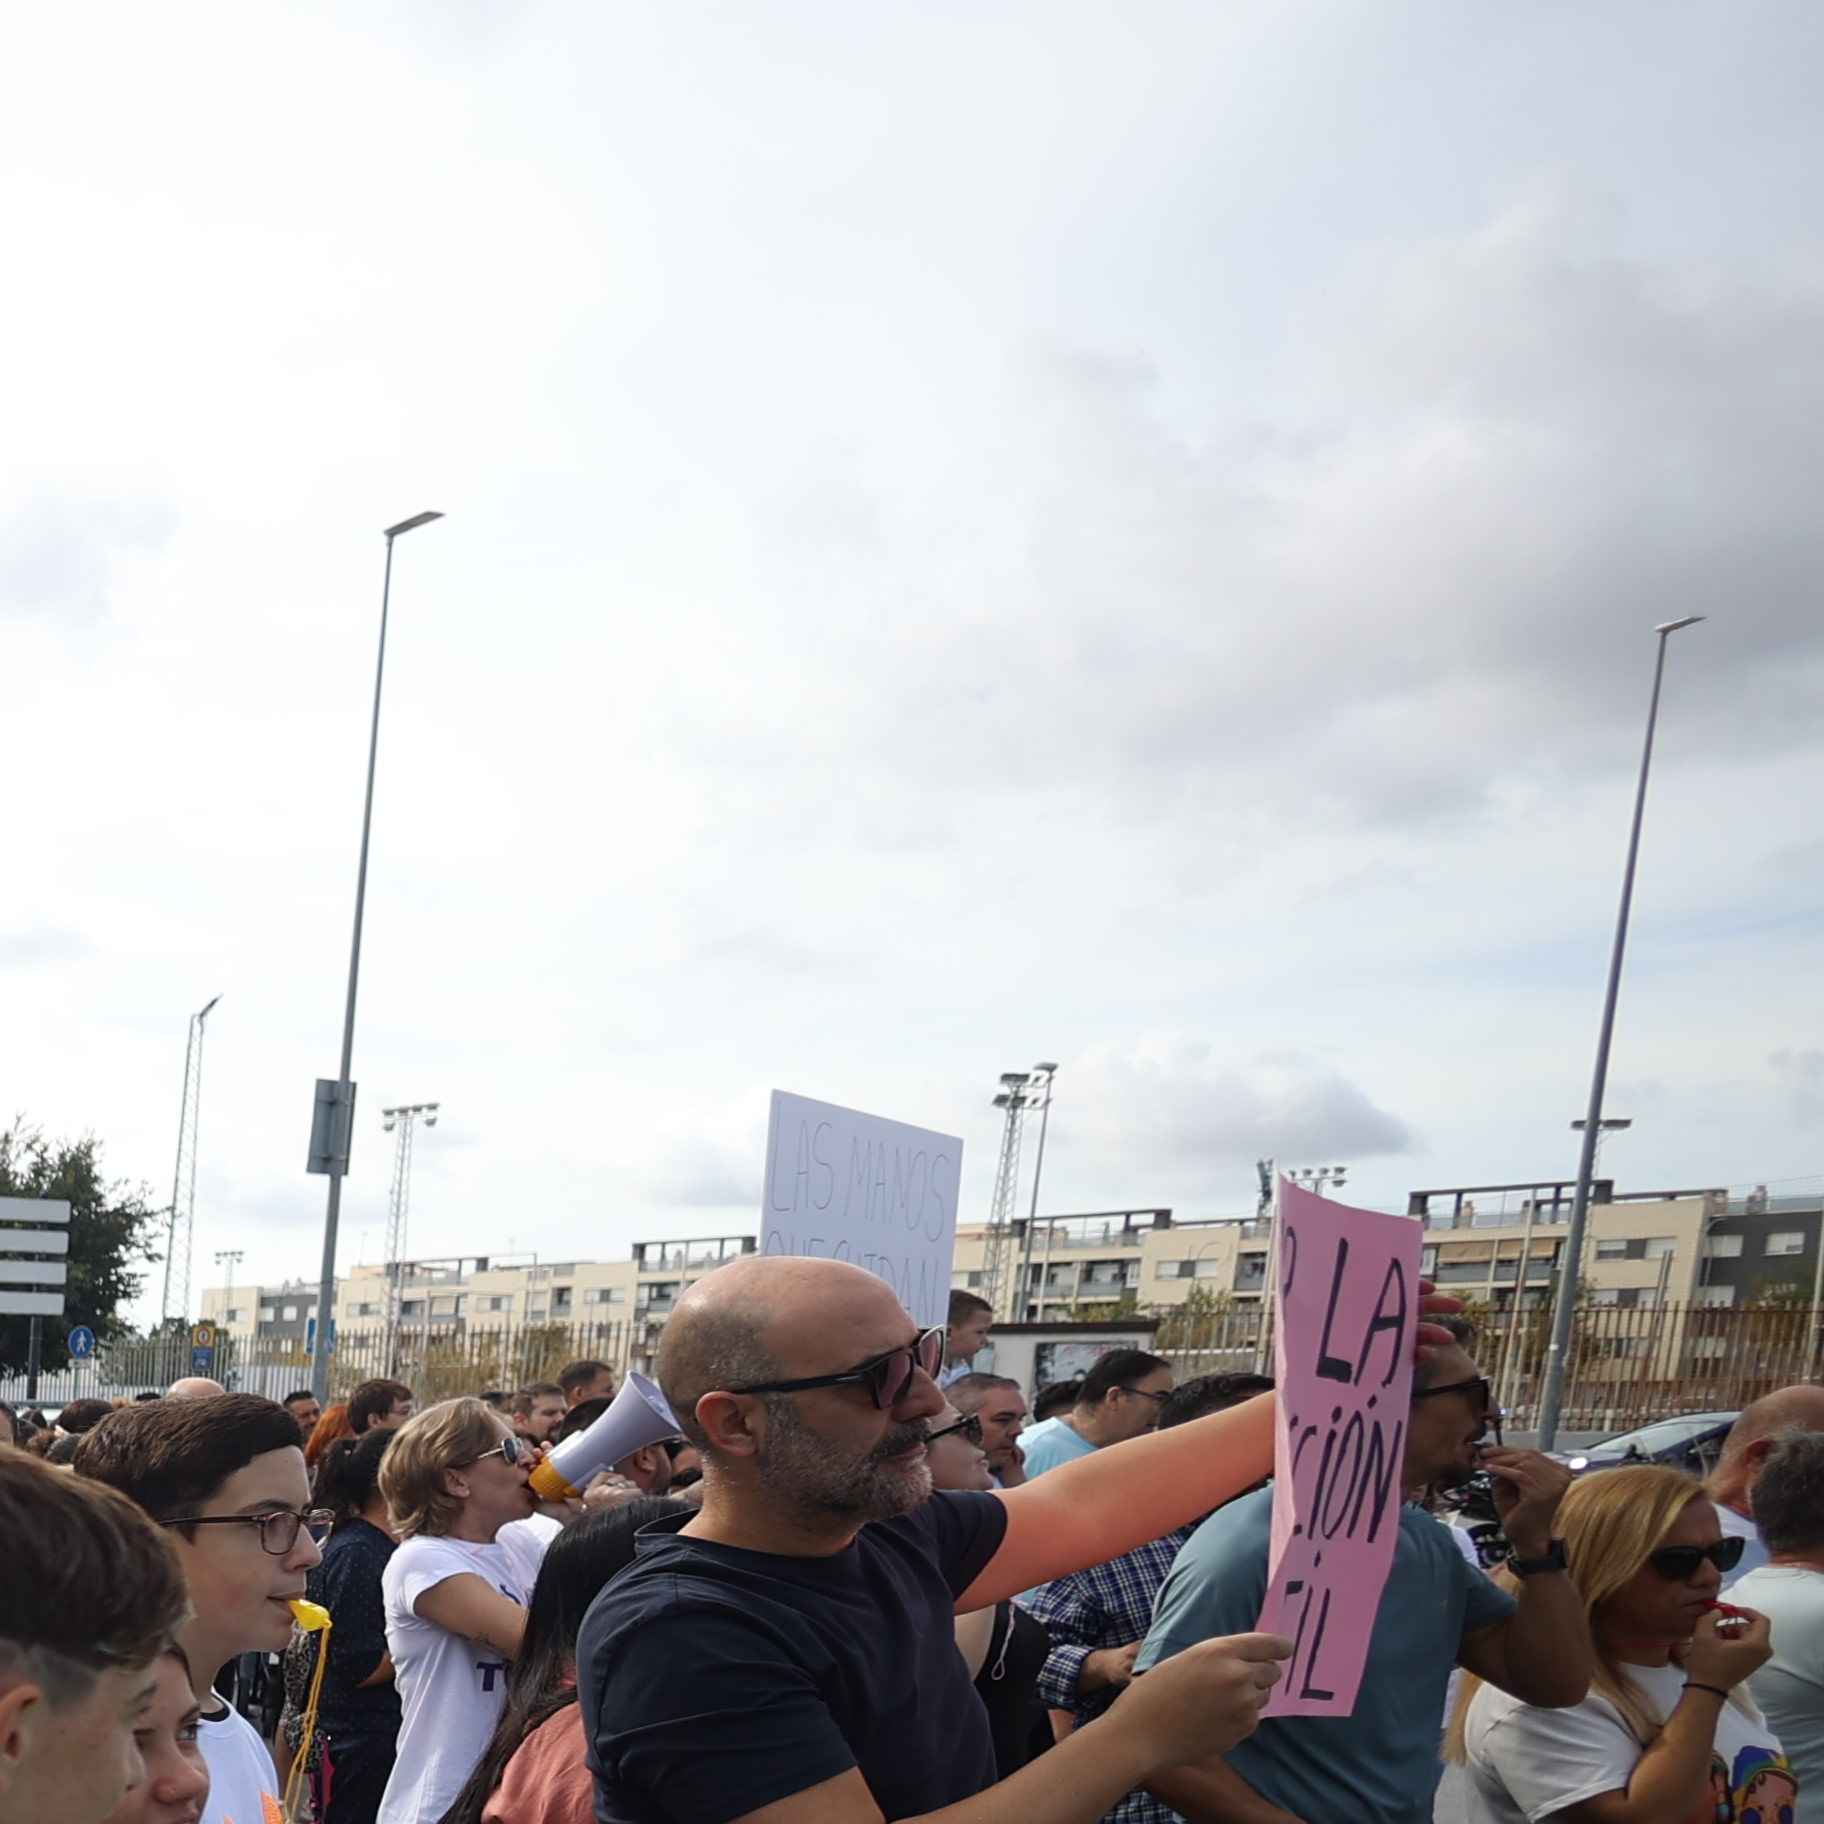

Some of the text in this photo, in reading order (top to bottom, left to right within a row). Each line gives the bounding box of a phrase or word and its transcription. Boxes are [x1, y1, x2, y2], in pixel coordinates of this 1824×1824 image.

[771, 1102, 950, 1243] LAS MANOS
[1316, 1237, 1408, 1387] LA
